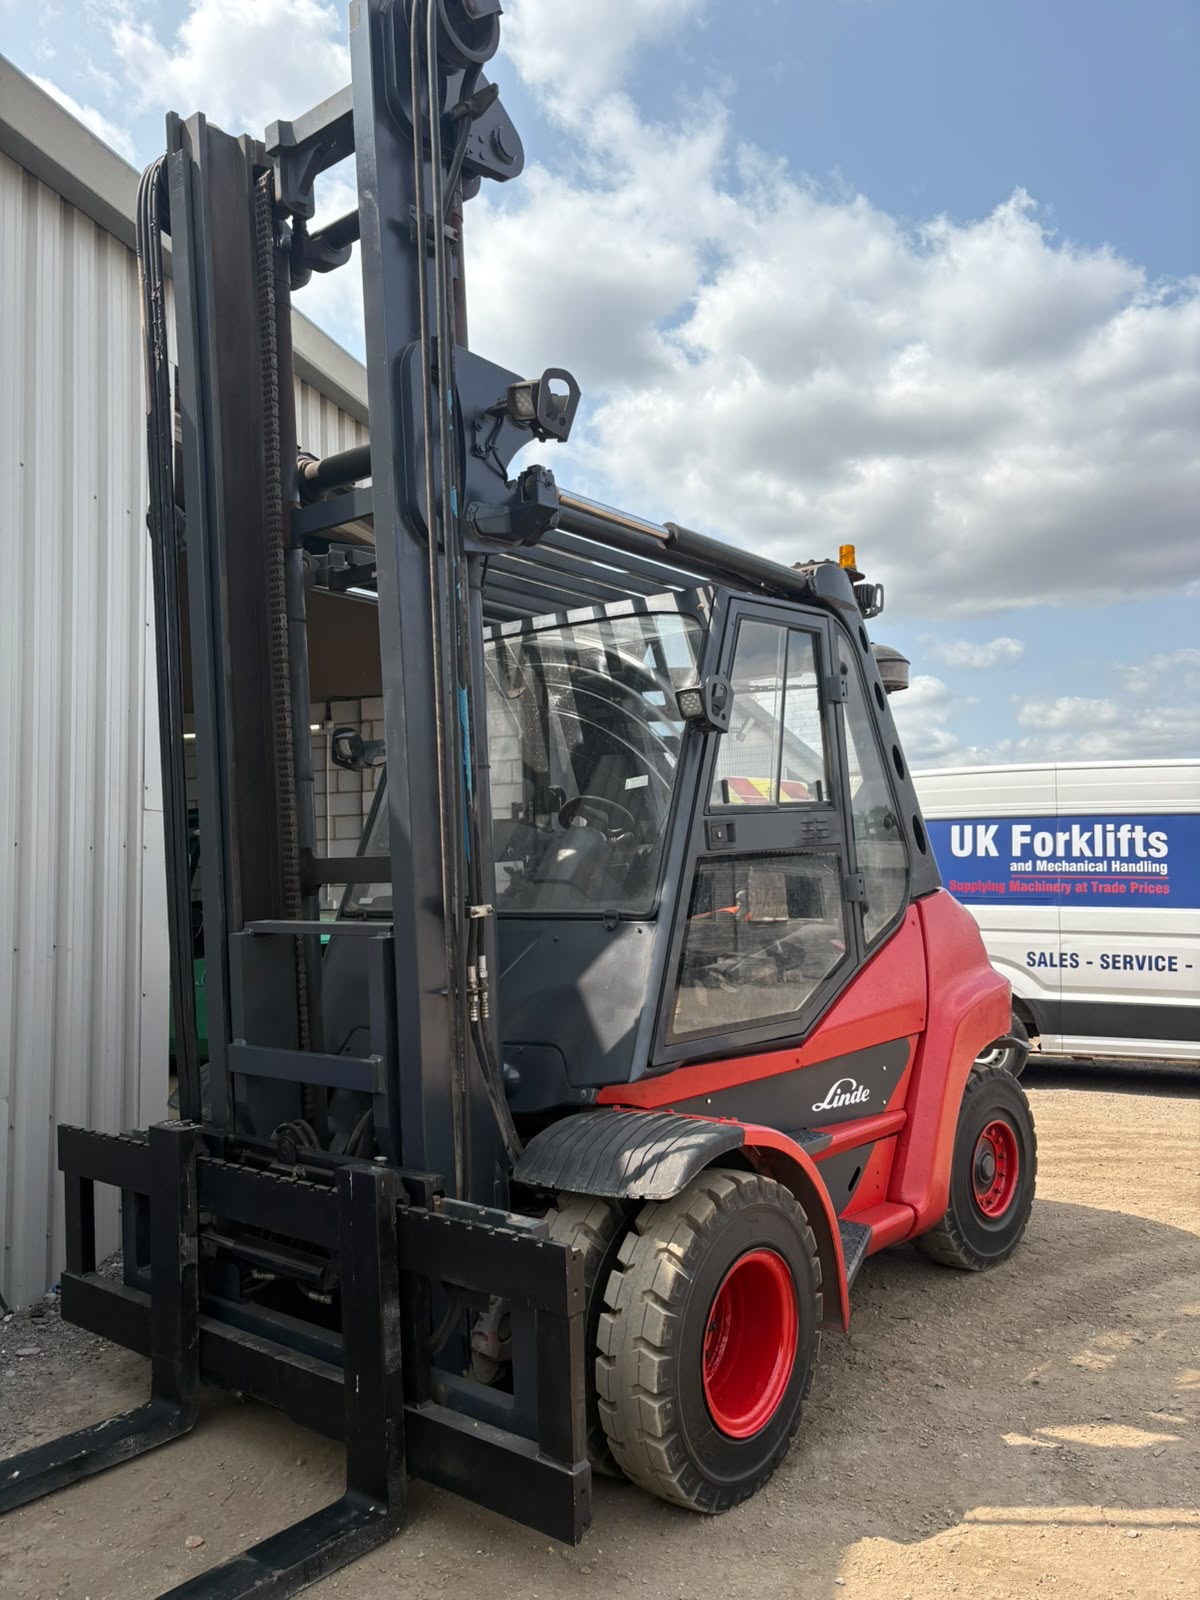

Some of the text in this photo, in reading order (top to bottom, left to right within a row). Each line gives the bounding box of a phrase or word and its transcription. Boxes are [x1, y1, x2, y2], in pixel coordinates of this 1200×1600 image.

[950, 824, 1168, 858] UK Forklifts
[1010, 860, 1168, 875] and Mechanical Handling
[949, 880, 1169, 894] Supplying Machinery at Trade Prices
[1026, 951, 1080, 968] SALES
[1100, 954, 1178, 971] SERVICE
[812, 1078, 870, 1112] Linde
